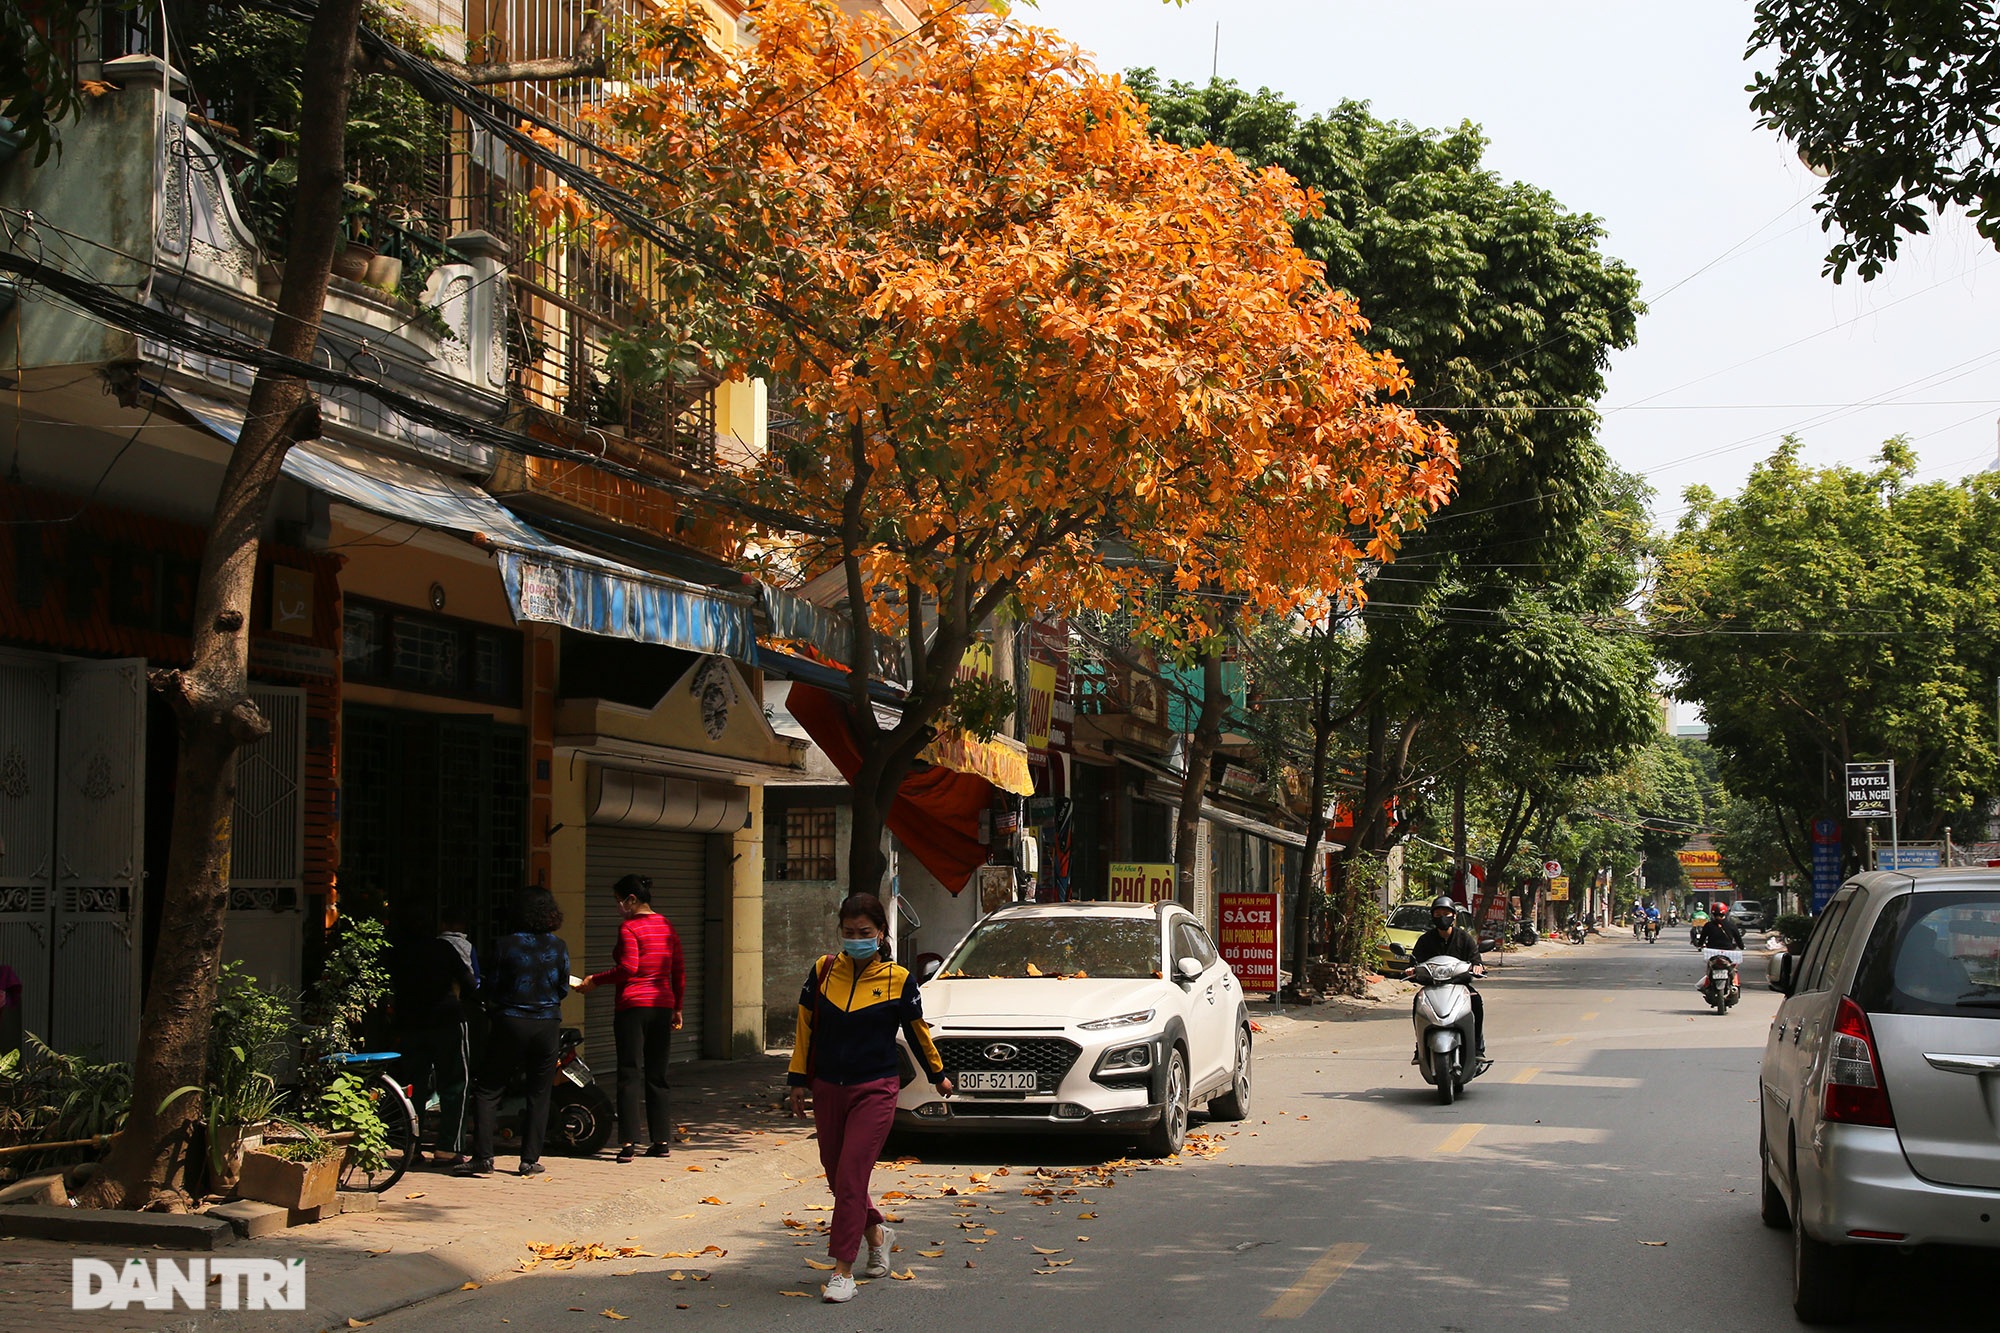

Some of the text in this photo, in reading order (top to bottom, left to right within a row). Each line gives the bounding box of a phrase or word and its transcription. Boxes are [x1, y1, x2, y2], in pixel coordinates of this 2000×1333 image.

[1851, 777, 1888, 786] HOTEL
[1849, 788, 1868, 801] NHÀ
[1110, 866, 1173, 903] PHỞ BÒ
[1224, 896, 1236, 905] NHÀ
[1224, 907, 1271, 923] SÁCH
[1234, 926, 1255, 943] PHÒNG
[1255, 924, 1273, 944] PHẨM
[1243, 946, 1273, 959] DÙNG
[1247, 964, 1273, 975] SINH
[960, 1073, 1035, 1089] 30F-521.20
